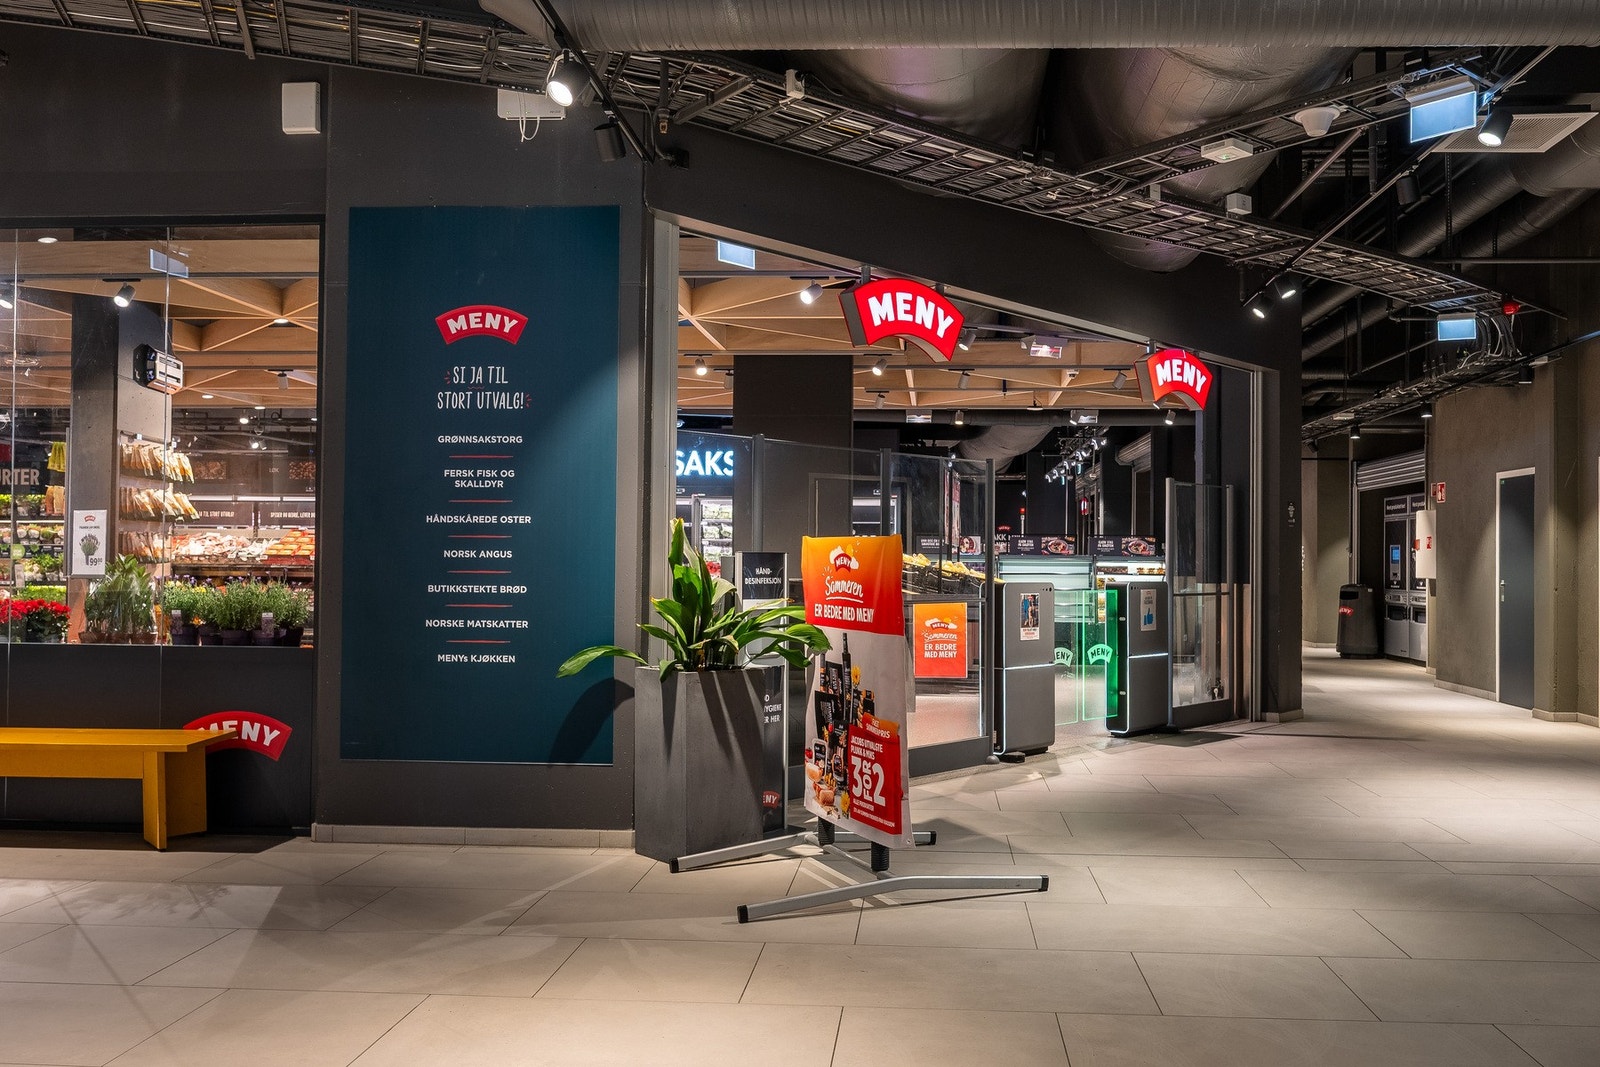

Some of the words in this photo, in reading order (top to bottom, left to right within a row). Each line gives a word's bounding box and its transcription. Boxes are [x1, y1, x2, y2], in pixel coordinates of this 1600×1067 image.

[868, 292, 954, 338] MENY
[446, 312, 518, 334] MENY
[453, 366, 466, 384] SI
[470, 366, 483, 384] JA
[488, 366, 508, 384] TIL
[1156, 358, 1206, 393] MENY
[437, 392, 472, 410] STORT
[477, 392, 524, 410] UTVALG!
[438, 435, 523, 444] GRØNNSAKSTORG
[0, 468, 40, 486] RTER
[444, 470, 474, 478] FERSK
[476, 470, 498, 478] FISK
[500, 470, 515, 478] OG
[454, 480, 504, 488] SKALLDYR
[426, 514, 498, 523] HÅNDSKÅREDE
[444, 550, 476, 558] NORSK
[479, 550, 512, 558] ANGUS
[836, 556, 850, 567] MENY
[428, 585, 498, 593] BUTIKKSTEKTE
[500, 585, 527, 594] BRØD
[825, 576, 863, 598] Sommeren
[814, 604, 822, 617] ER
[824, 604, 842, 620] BEDRE
[843, 607, 855, 620] MED
[856, 608, 875, 623] MENY
[425, 620, 464, 628] NORSKE
[467, 620, 528, 628] MATSKATTER
[1056, 652, 1070, 660] ENY
[1091, 648, 1110, 658] MENY
[437, 654, 468, 662] MENYs
[471, 654, 516, 663] KJØKKEN
[851, 755, 862, 797] 3
[863, 760, 872, 802] FOR
[872, 763, 886, 807] 2
